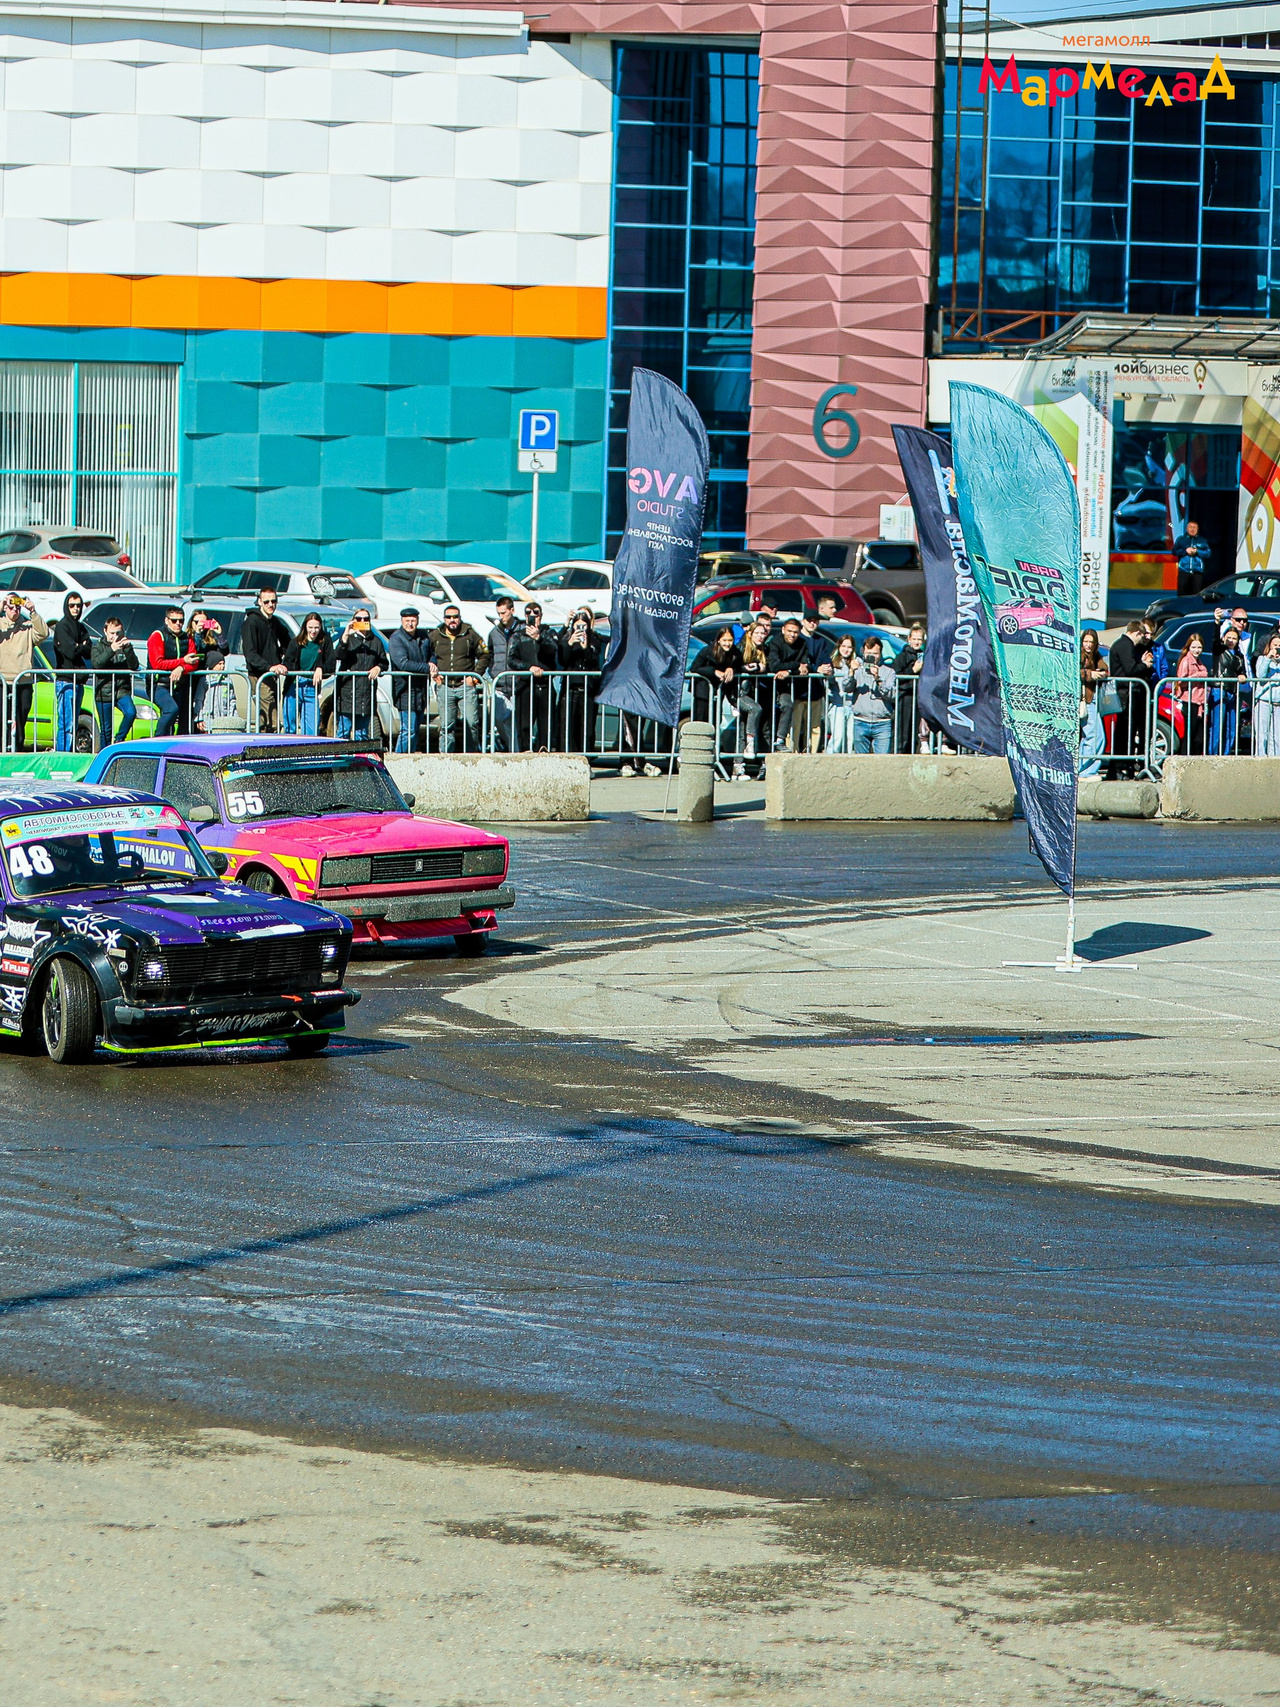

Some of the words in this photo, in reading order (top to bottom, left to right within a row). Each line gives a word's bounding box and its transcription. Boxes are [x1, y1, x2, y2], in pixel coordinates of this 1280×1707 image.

[529, 415, 551, 446] P
[812, 383, 860, 458] 6
[1097, 474, 1106, 506] твори
[1085, 551, 1102, 611] бизнес
[23, 810, 125, 828] АВТОМНОГОБОРЬЕ
[228, 790, 265, 818] 55
[9, 844, 55, 879] 48
